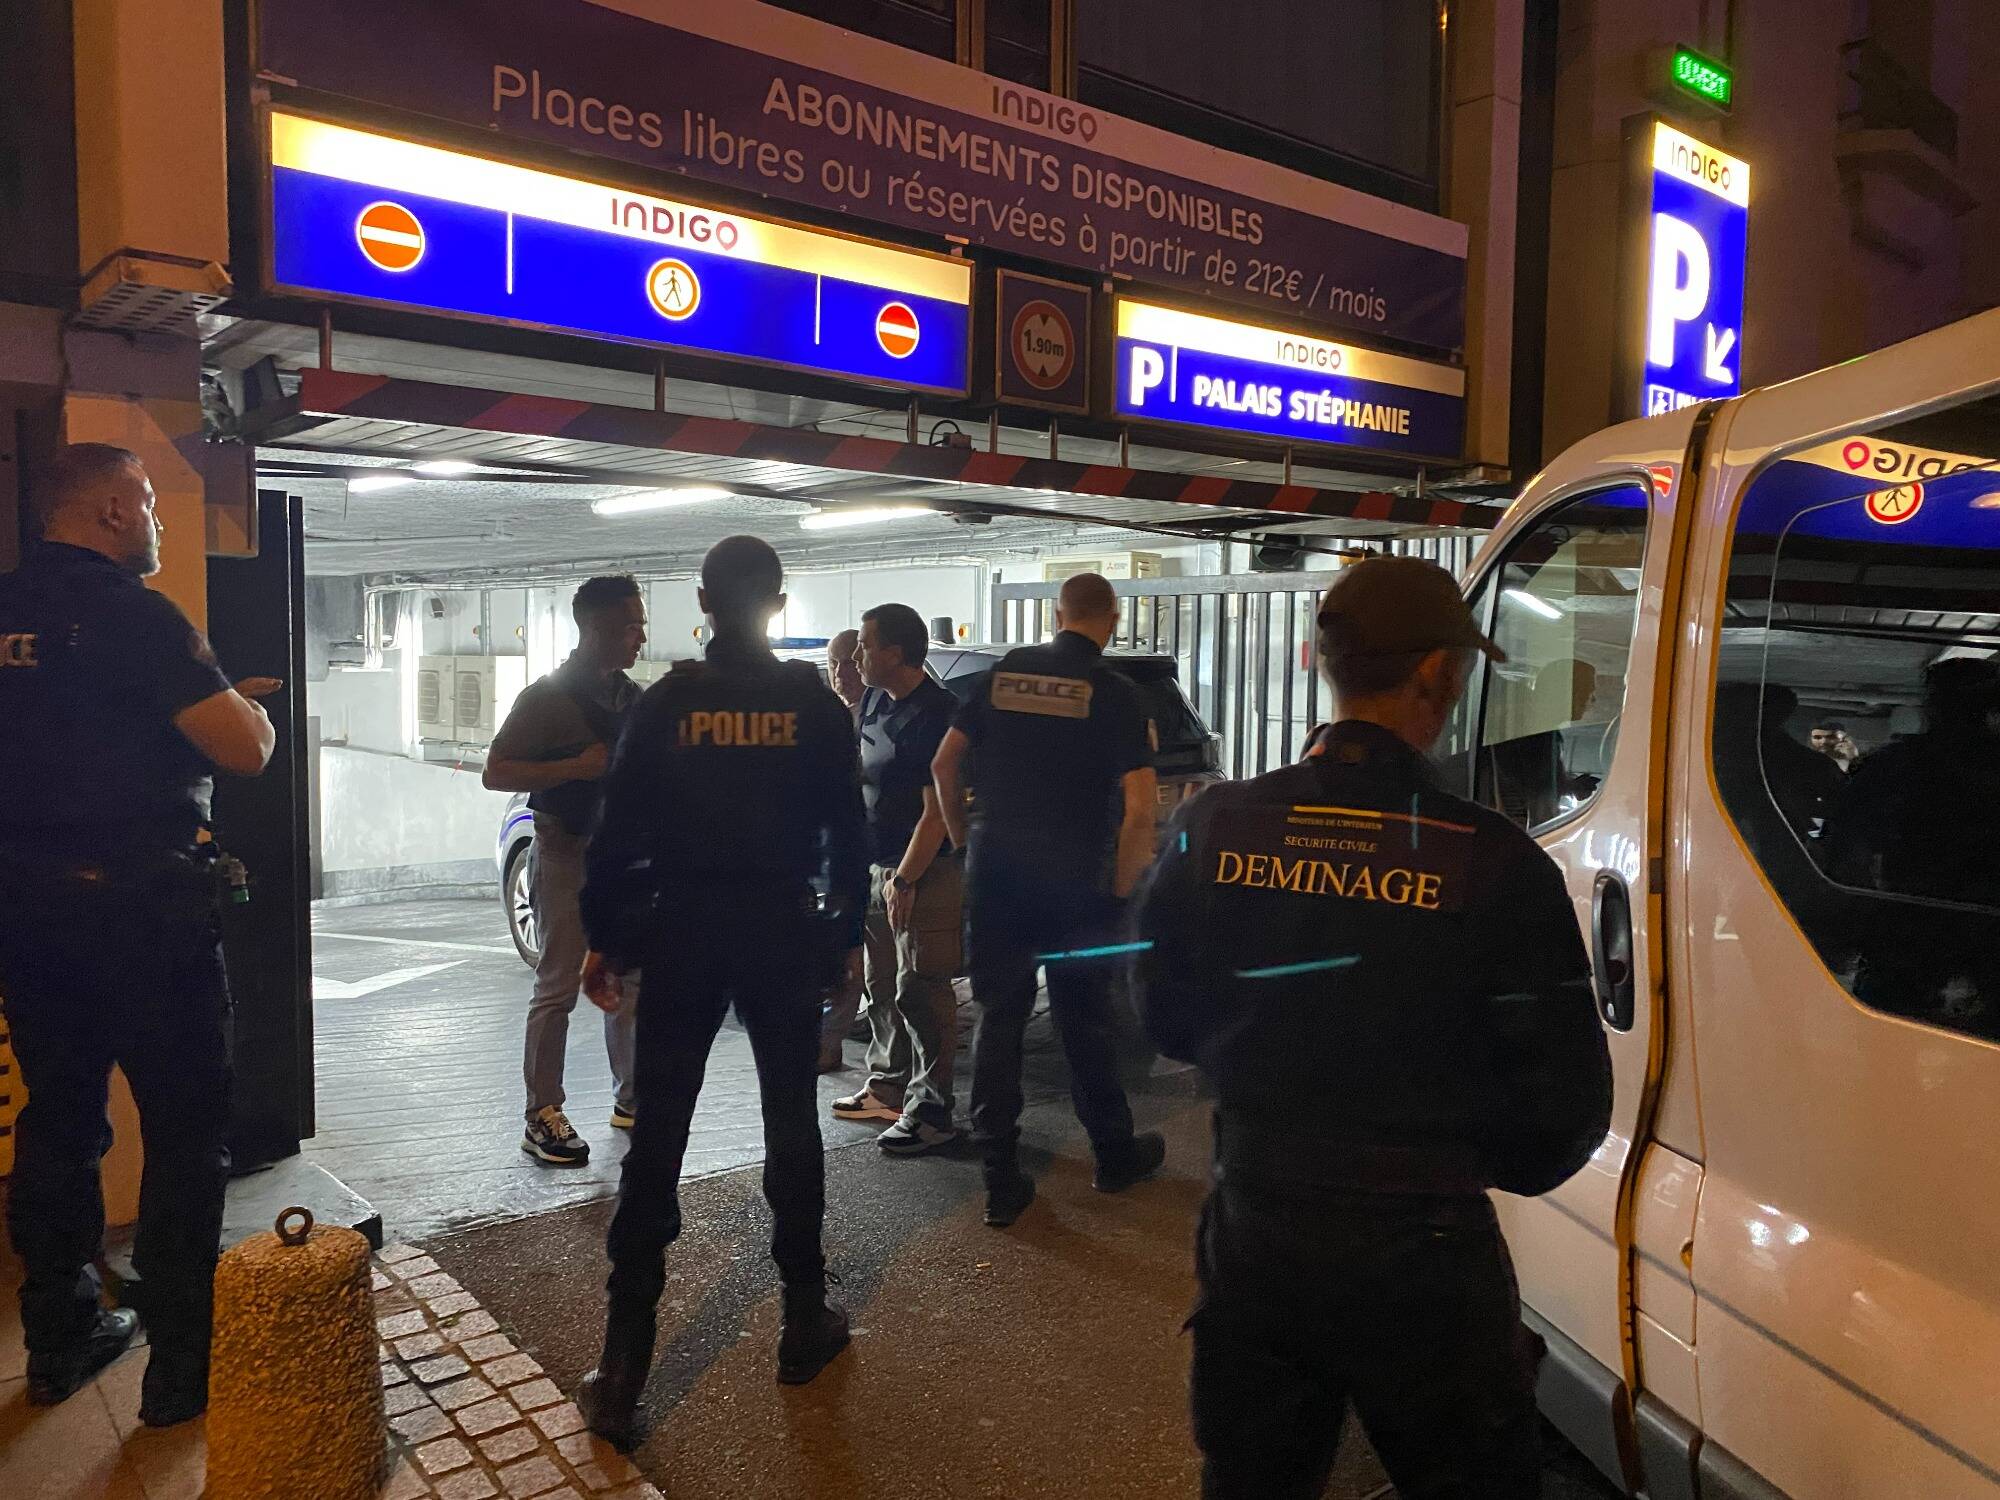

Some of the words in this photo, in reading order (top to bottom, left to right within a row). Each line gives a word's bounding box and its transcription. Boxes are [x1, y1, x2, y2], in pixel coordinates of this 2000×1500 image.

[992, 85, 1098, 144] INDIGO
[762, 77, 1061, 193] ABONNEMENTS
[1072, 163, 1264, 245] DISPONIBLES
[1671, 140, 1731, 191] INDIGO
[492, 65, 664, 148] Places
[684, 109, 805, 183] libres
[820, 159, 871, 199] ou
[887, 170, 1066, 249] réservées
[1078, 213, 1097, 254] à
[1110, 230, 1196, 276] partir
[1203, 248, 1237, 287] de
[1244, 258, 1304, 302] 212€
[1307, 273, 1324, 308] /
[1329, 286, 1387, 322] mois
[612, 198, 738, 251] INDIGO
[1648, 212, 1711, 368] P
[1023, 328, 1065, 357] 1.90m
[1276, 340, 1342, 370] INDIGO
[1129, 346, 1165, 406] P
[1192, 374, 1283, 417] PALAIS
[1288, 389, 1411, 436] STÉPHANIE
[998, 677, 1088, 700] POLICE
[690, 711, 798, 746] POLICE
[1339, 839, 1379, 853] CIVILE
[1215, 850, 1442, 910] DEMINAGE
